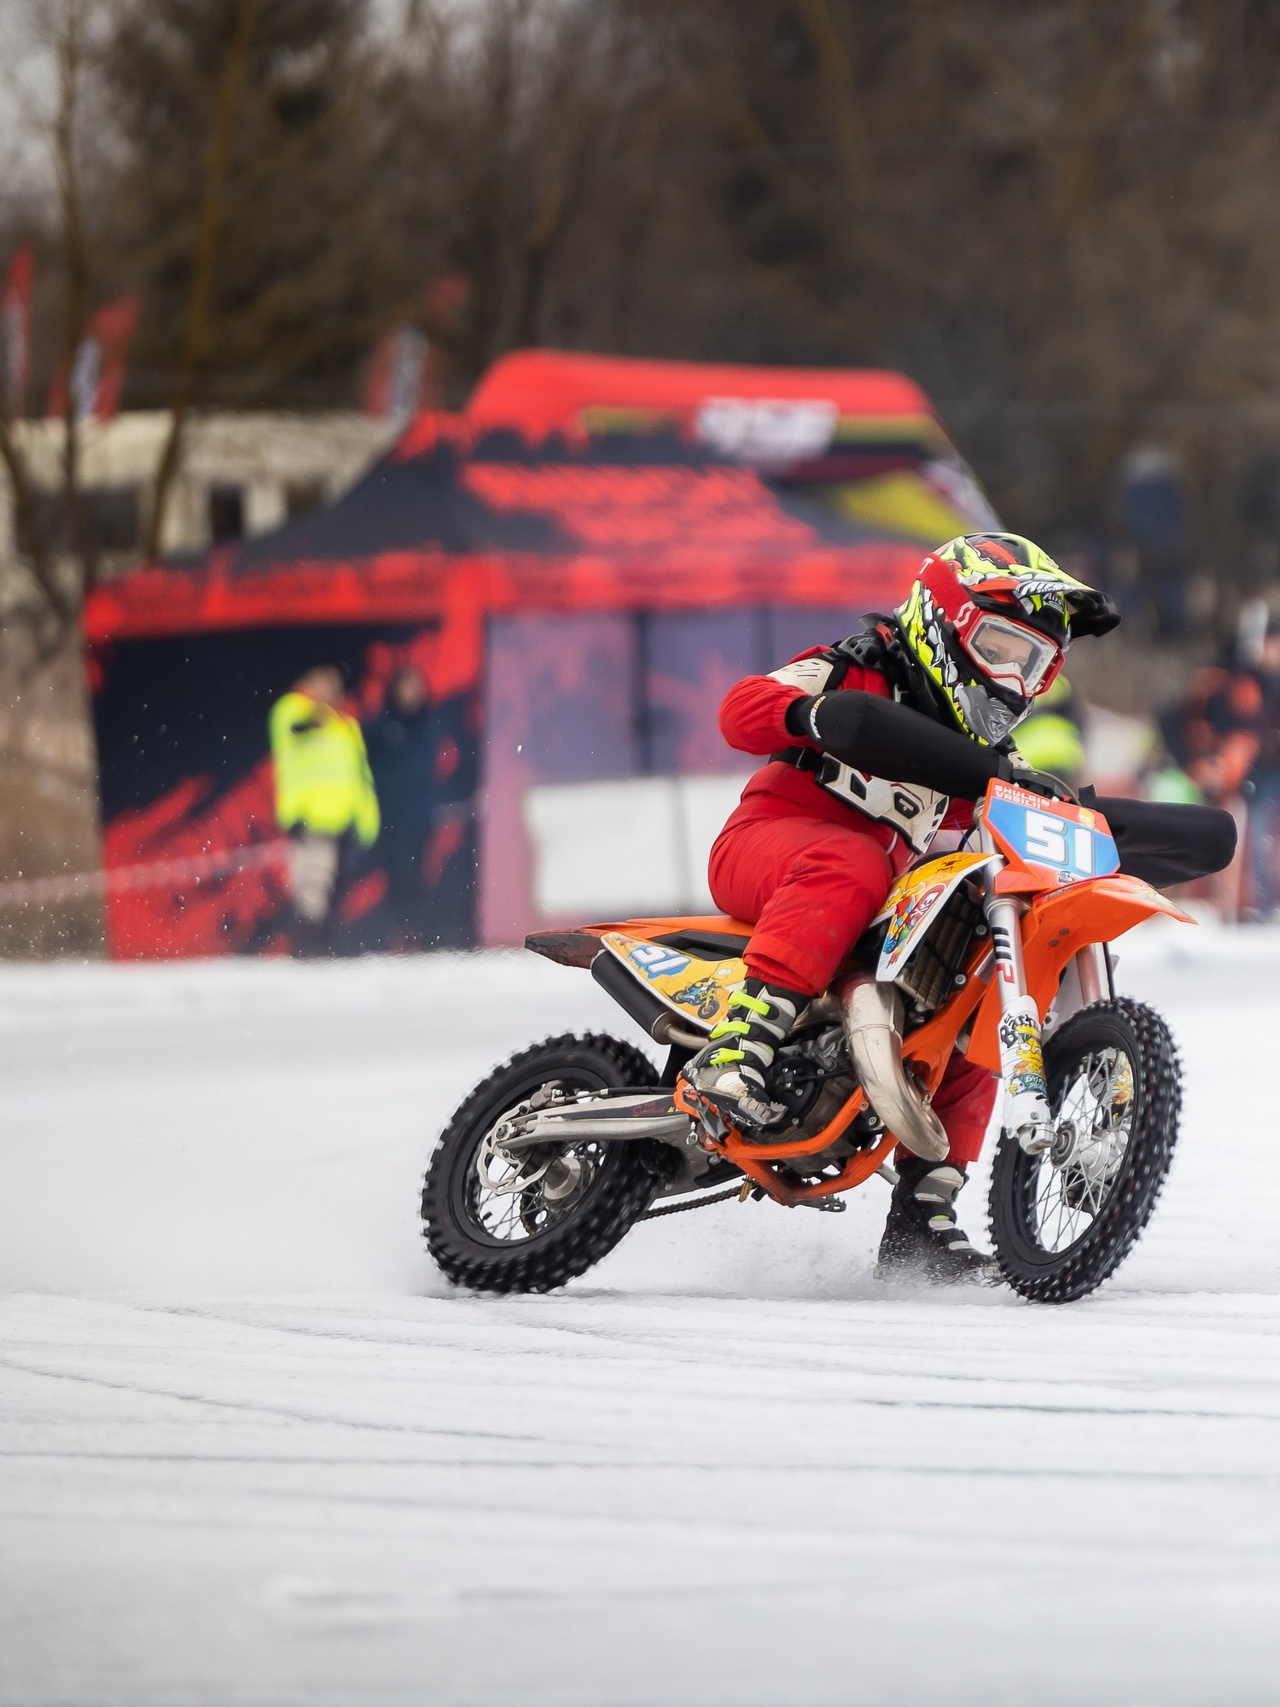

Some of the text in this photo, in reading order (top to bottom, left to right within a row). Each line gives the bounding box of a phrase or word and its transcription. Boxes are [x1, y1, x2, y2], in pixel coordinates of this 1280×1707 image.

[994, 784, 1050, 807] SHULGIN
[1026, 810, 1096, 876] 51
[629, 945, 691, 974] 51
